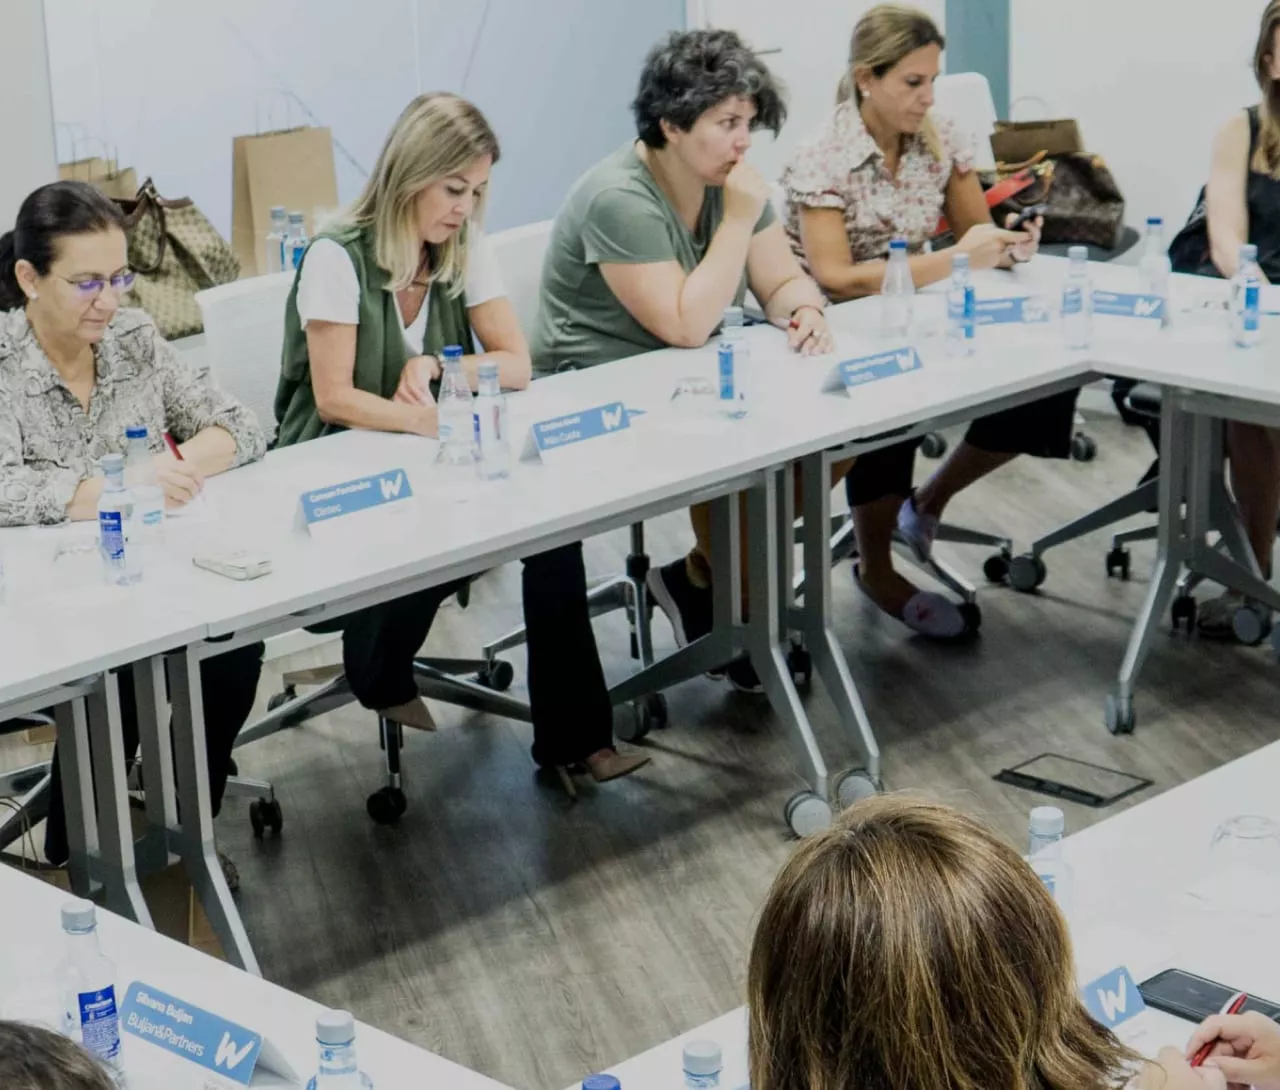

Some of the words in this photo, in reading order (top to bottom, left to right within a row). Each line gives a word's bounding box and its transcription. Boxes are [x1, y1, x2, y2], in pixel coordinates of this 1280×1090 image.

[379, 472, 403, 500] W
[166, 1003, 194, 1025] Buljan
[1096, 974, 1127, 1022] W
[127, 1011, 205, 1057] Buljan&Partners
[214, 1030, 256, 1080] W
